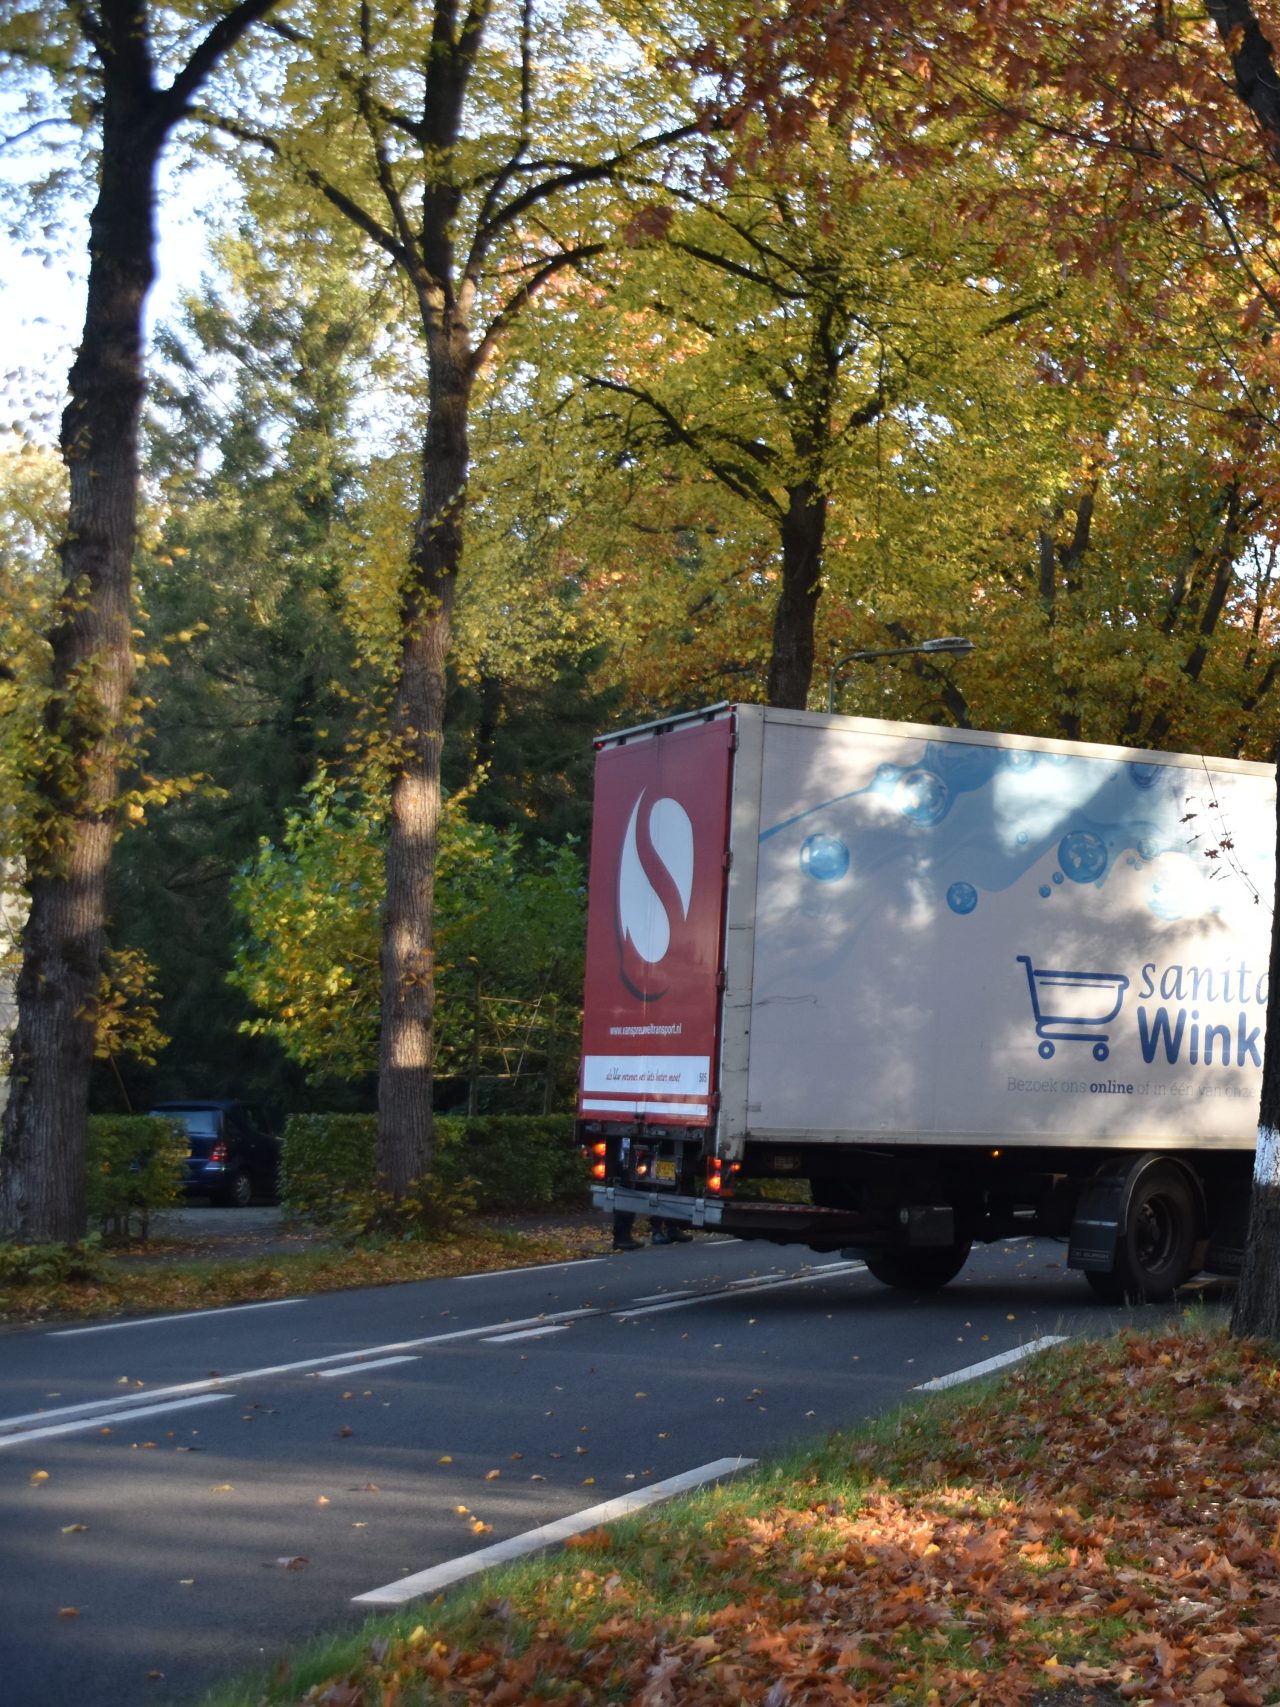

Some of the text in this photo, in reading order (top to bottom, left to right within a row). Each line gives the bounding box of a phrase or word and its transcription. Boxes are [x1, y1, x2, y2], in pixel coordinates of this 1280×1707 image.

[1137, 1005, 1262, 1068] Wink
[1007, 1076, 1257, 1098] Bezoek ons online of in één van onze
